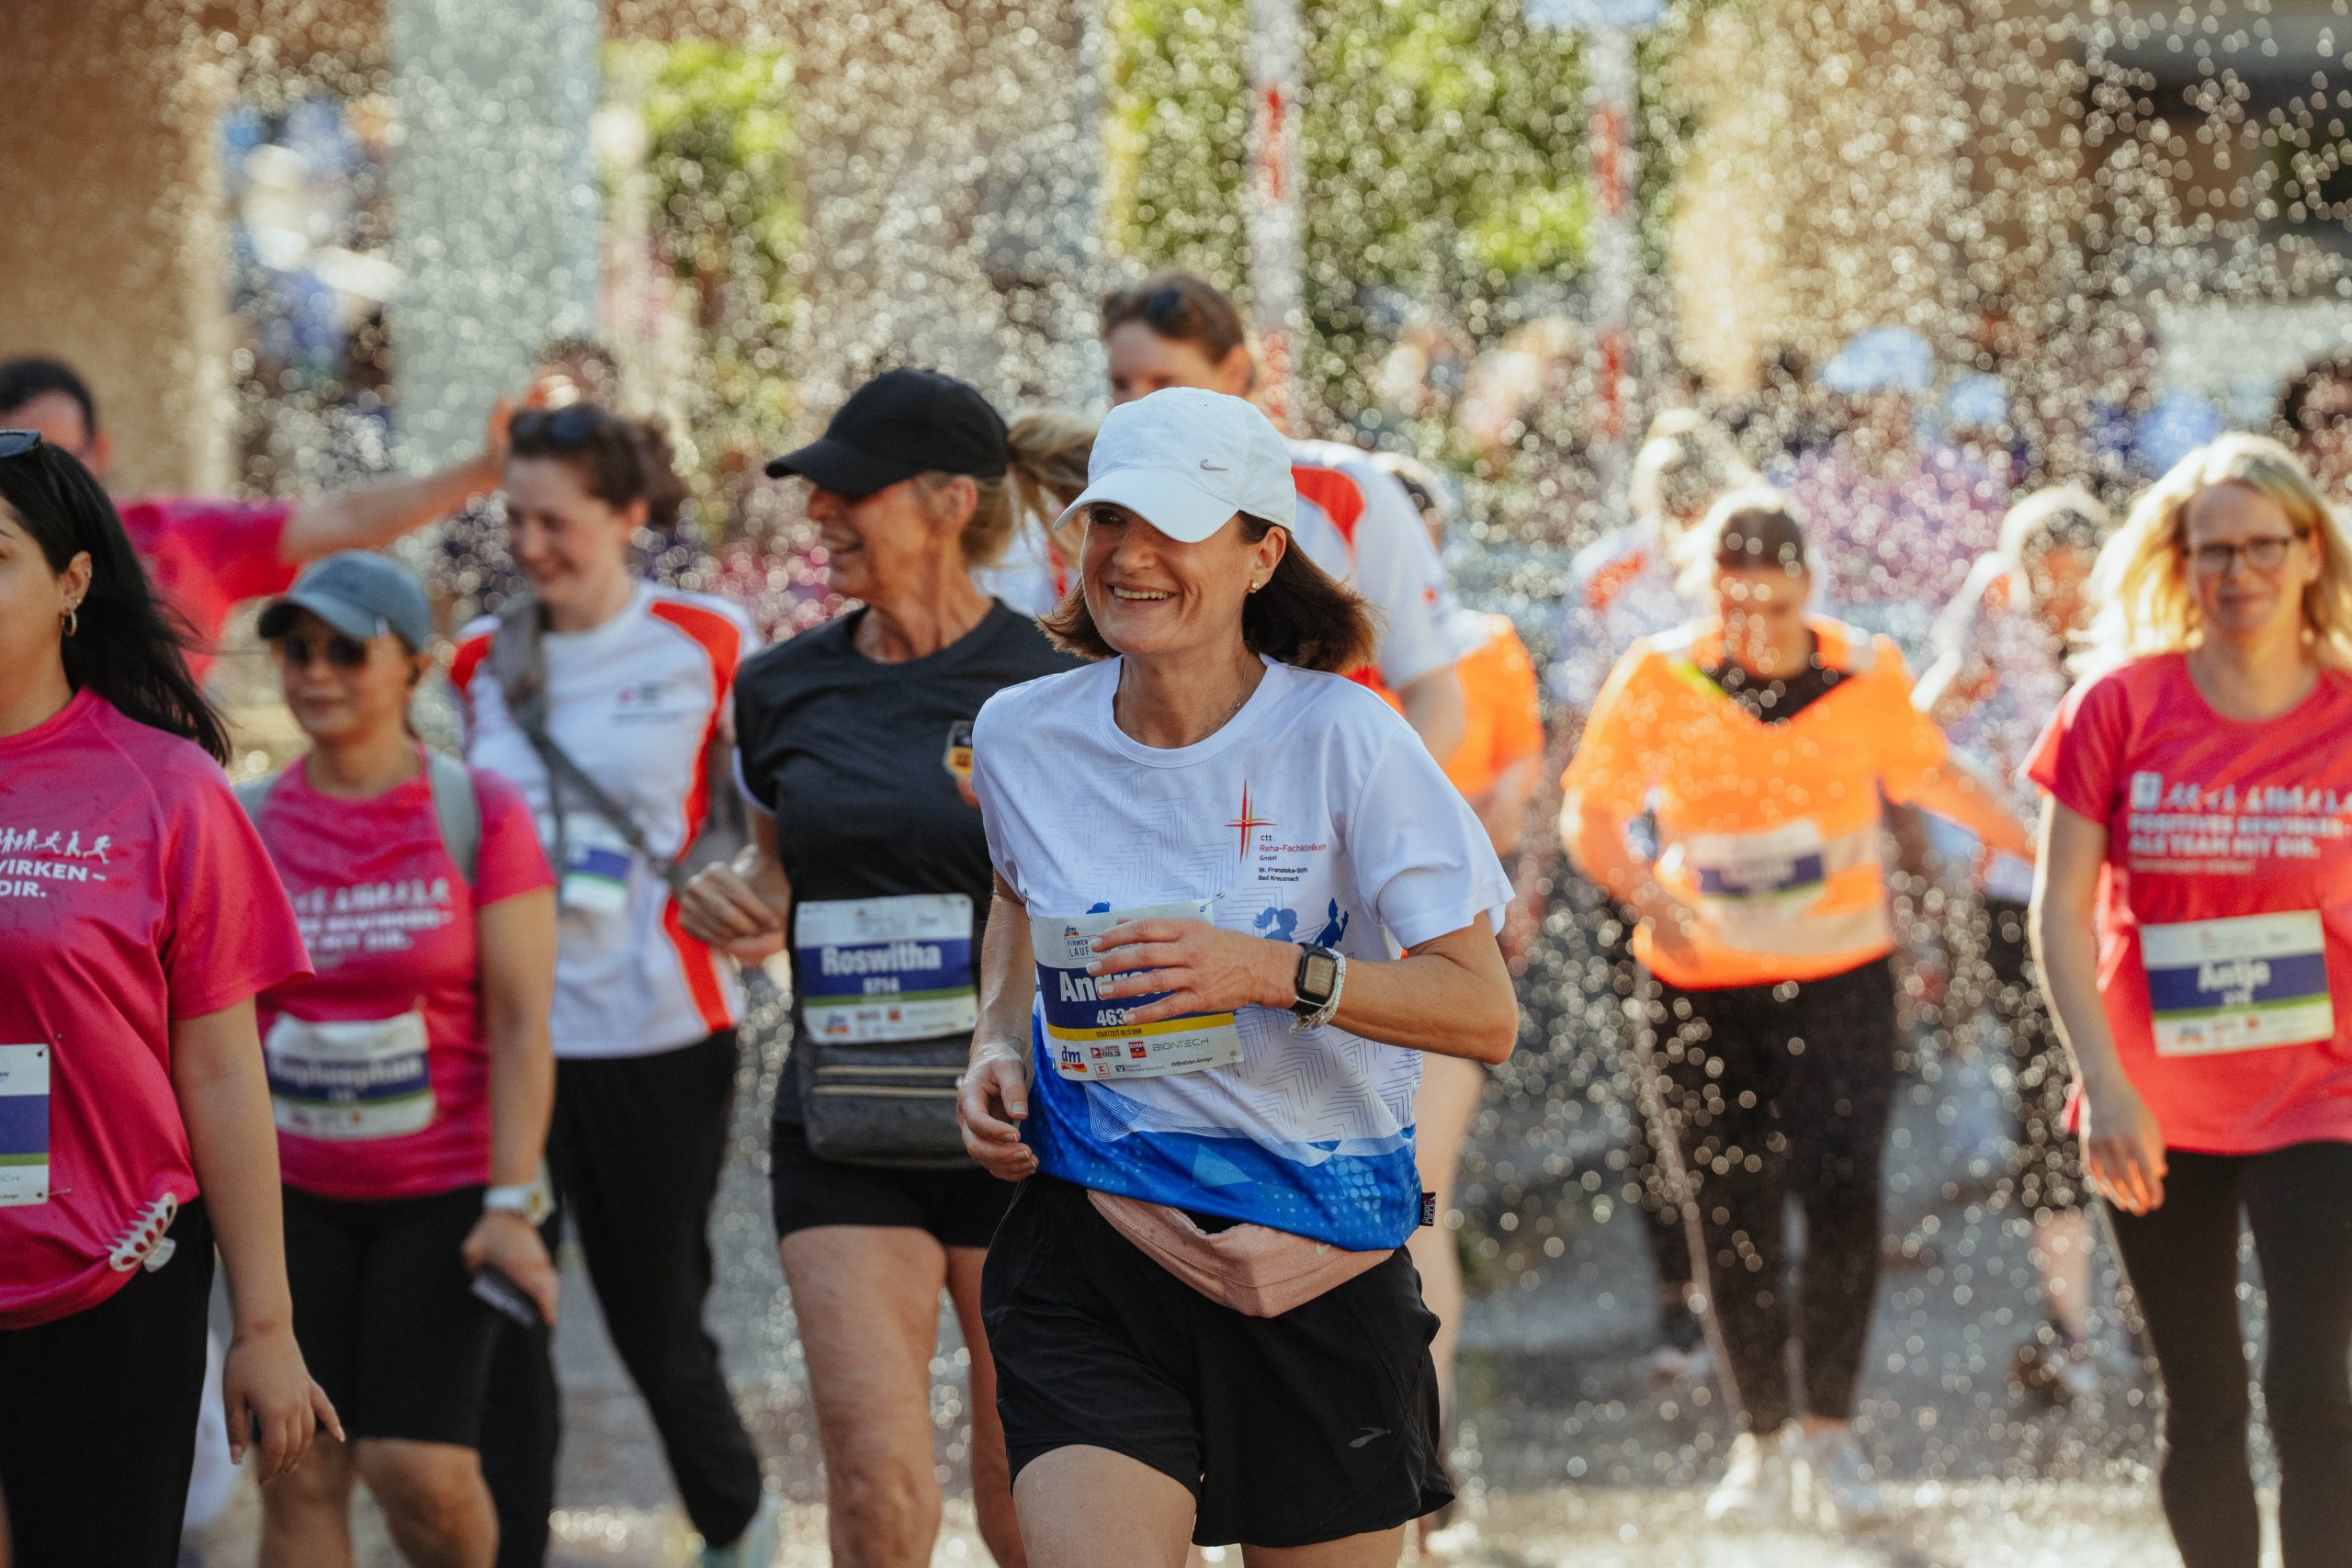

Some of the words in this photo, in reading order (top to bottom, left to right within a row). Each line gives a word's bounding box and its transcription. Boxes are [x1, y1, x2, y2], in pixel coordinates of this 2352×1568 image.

[1260, 843, 1326, 852] Reha-Fachkliniken
[820, 941, 943, 976] Roswitha
[1069, 947, 1091, 957] LAUF
[1096, 1008, 1137, 1026] 463
[1152, 1037, 1209, 1051] BIONTECH
[1061, 1045, 1081, 1063] dm
